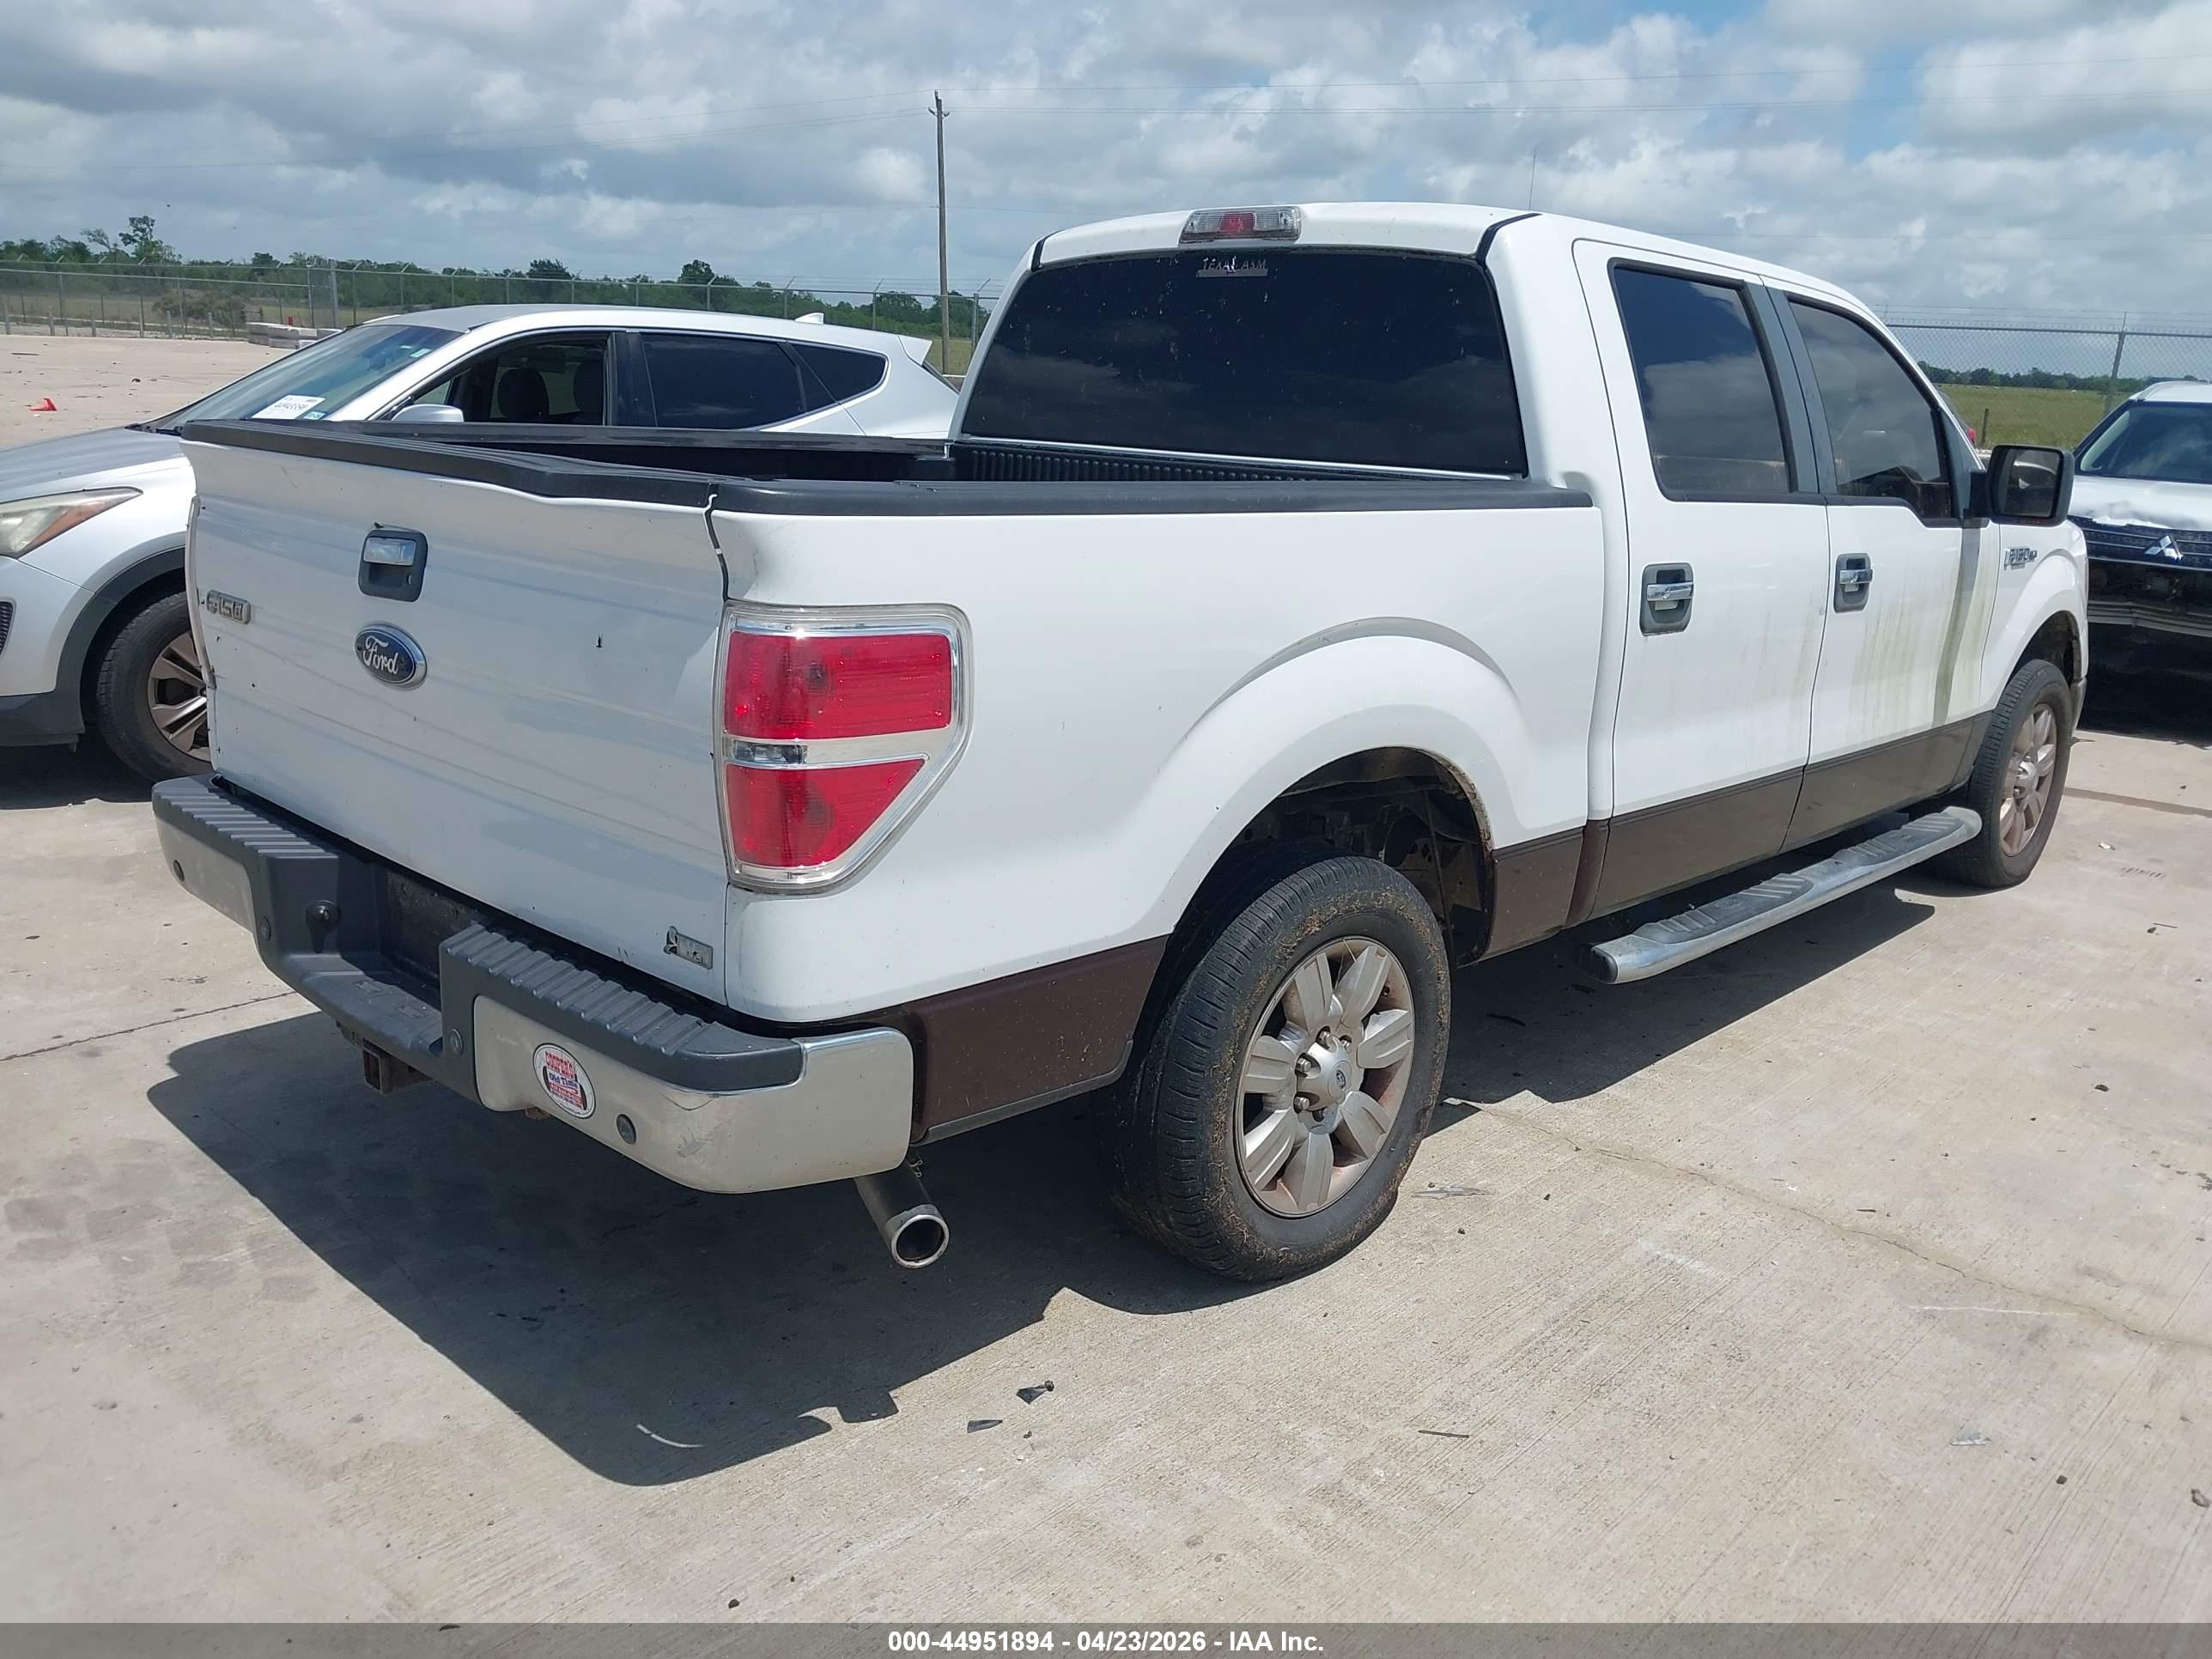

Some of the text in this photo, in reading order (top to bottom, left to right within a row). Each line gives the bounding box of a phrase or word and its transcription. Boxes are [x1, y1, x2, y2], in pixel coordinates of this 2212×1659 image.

[362, 635, 399, 675] Ford
[549, 1072, 579, 1089] Old Time
